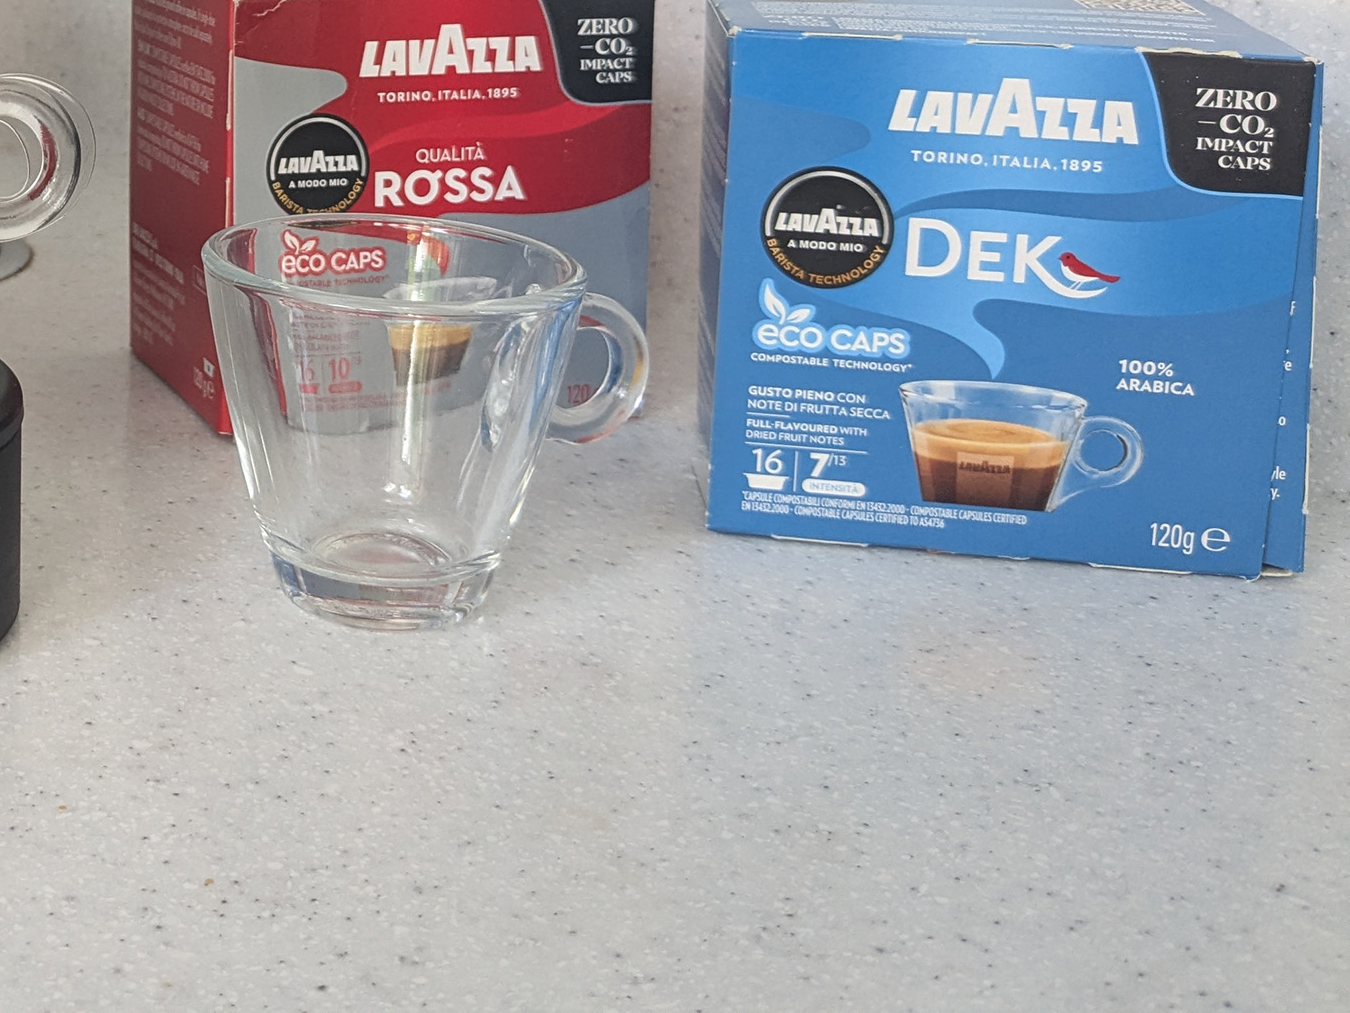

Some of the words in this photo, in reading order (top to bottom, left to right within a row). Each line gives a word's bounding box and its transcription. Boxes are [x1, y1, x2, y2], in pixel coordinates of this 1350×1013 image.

[577, 17, 633, 36] ZERO
[359, 23, 542, 78] LAVAZZA
[579, 57, 633, 71] IMPACT
[595, 71, 632, 84] CAPS
[487, 87, 518, 99] 1895
[1195, 88, 1277, 111] ZERO
[888, 77, 1139, 145] LAVAZZA
[415, 141, 485, 163] QUALITÀ
[1195, 137, 1273, 154] IMPACT
[277, 150, 360, 174] LAVAZZA
[1061, 159, 1103, 173] 1895
[1218, 155, 1271, 171] CAPS
[289, 180, 295, 188] A
[298, 179, 327, 188] MODO
[329, 178, 348, 187] MIO
[272, 181, 304, 215] BARISTA
[774, 208, 880, 237] LAVAZZA
[787, 240, 796, 248] A
[799, 240, 836, 250] MODO
[839, 243, 864, 253] MIO
[331, 250, 384, 270] CAPS
[767, 238, 805, 279] BARISTA
[808, 245, 886, 285] TECHNOLOGY
[905, 217, 1108, 299] DEK
[830, 329, 906, 355] CAPS
[750, 352, 829, 367] COMPOSTABLE
[1118, 359, 1174, 377] 100%
[748, 385, 792, 398] GUSTO
[794, 389, 835, 402] PIENO
[836, 392, 867, 405] CON
[1115, 378, 1195, 396] ARABICA
[747, 399, 782, 411] NOTE
[784, 402, 798, 412] DI
[800, 403, 847, 416] FRUTTA
[849, 407, 891, 420] SECCA
[745, 429, 776, 440] DRIED
[778, 432, 807, 441] FRUIT
[809, 435, 845, 446] NOTES
[746, 419, 838, 434] FULL-FLAVOURED
[839, 426, 868, 436] WITH
[752, 448, 783, 474] 16
[809, 482, 859, 494] INTENSITÀ
[741, 501, 751, 510] EN
[794, 505, 840, 519] COMPOSTABLE
[841, 510, 875, 522] CAPSULES
[875, 513, 909, 525] CERTIFIED
[909, 516, 919, 526] TO
[821, 497, 855, 510] CONFORMI
[856, 500, 866, 510] EN
[910, 505, 957, 519] COMPOSTABLE
[958, 510, 992, 522] CAPSULES
[993, 514, 1027, 525] CERTIFIED
[1150, 523, 1195, 554] 120g
